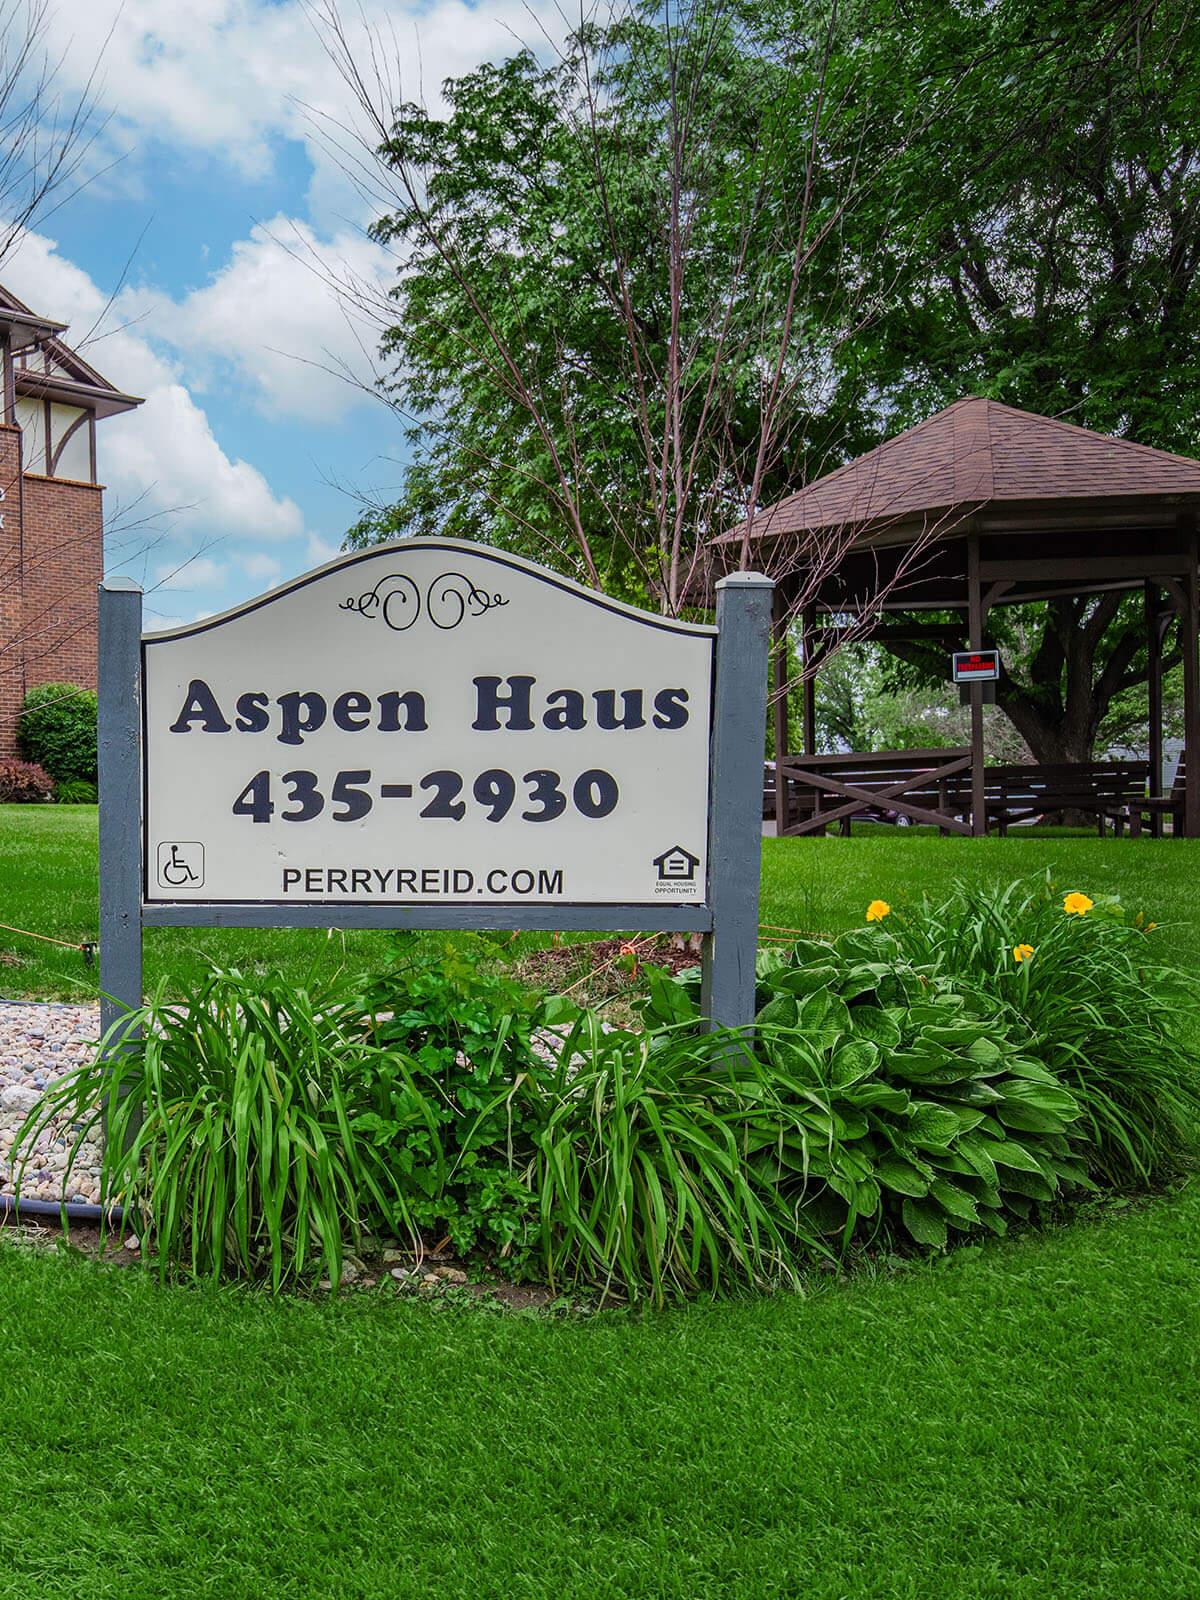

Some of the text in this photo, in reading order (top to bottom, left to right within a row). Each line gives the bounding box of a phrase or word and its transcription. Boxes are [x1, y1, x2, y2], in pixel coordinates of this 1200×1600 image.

[169, 675, 690, 746] Aspen Haus
[232, 768, 620, 824] 435-2930
[282, 868, 564, 895] PERRYREID.COM
